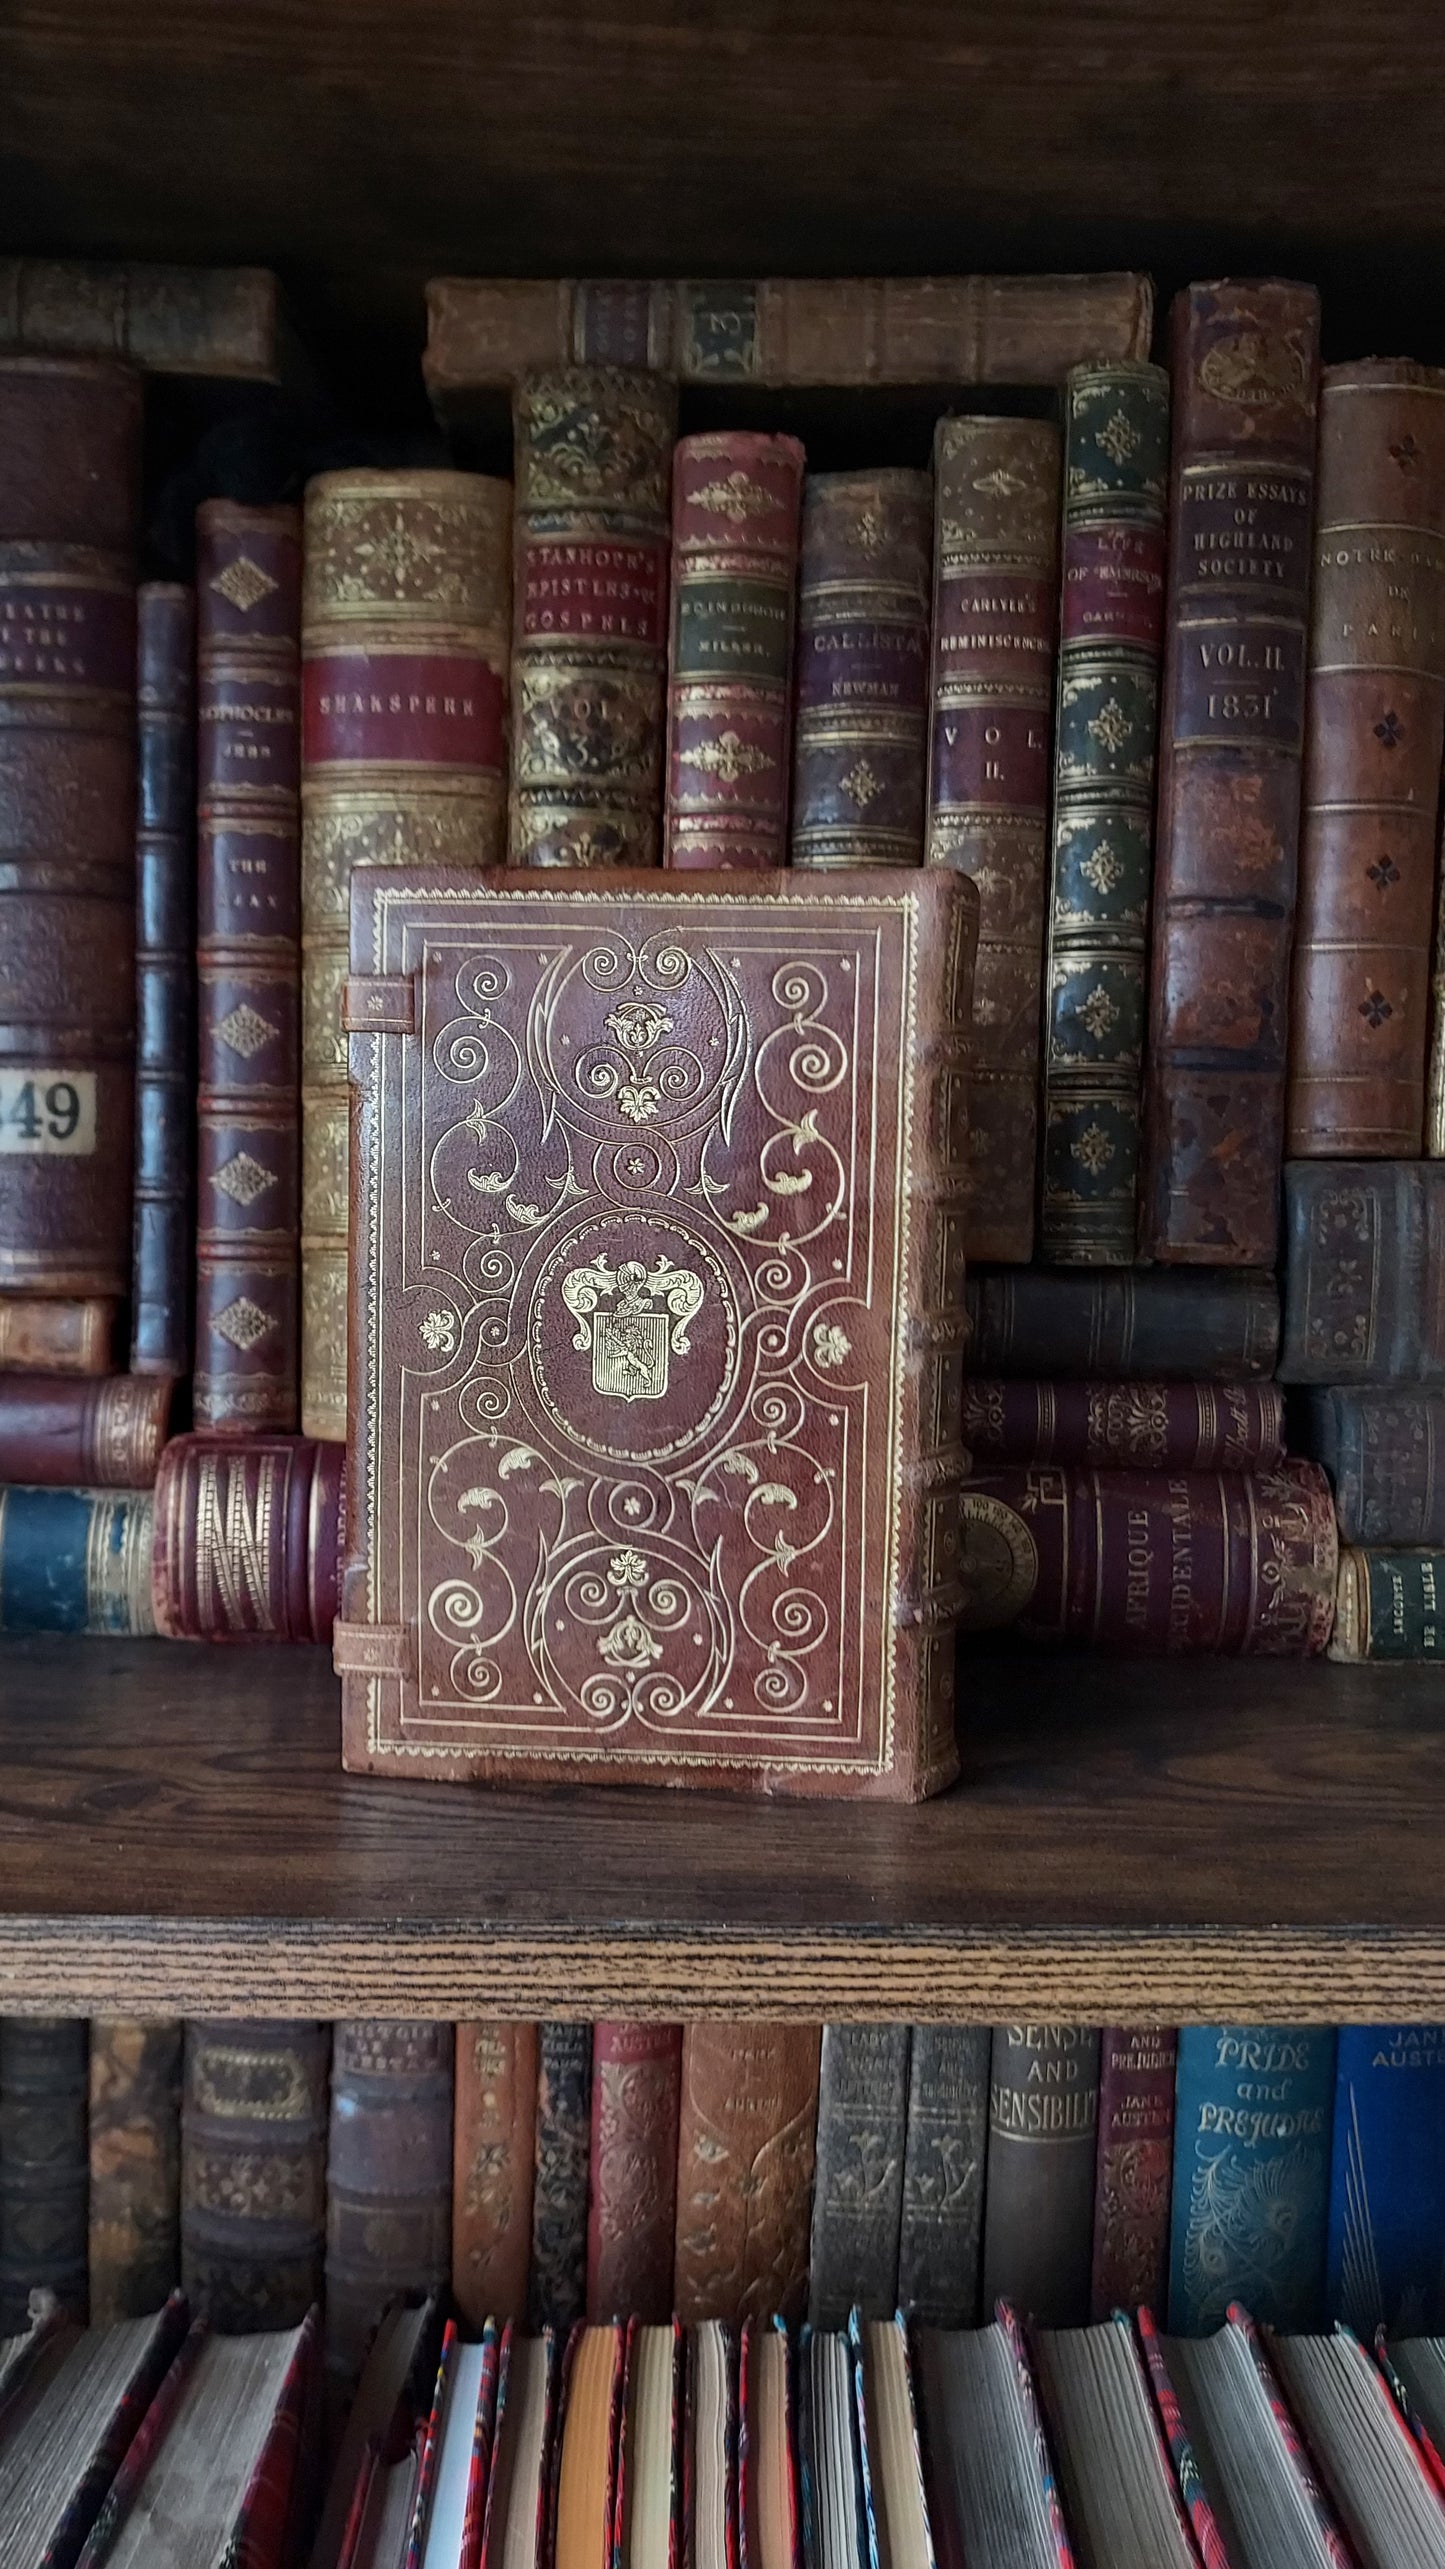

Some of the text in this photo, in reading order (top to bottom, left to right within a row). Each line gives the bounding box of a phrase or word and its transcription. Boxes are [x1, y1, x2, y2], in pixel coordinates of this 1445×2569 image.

[1182, 482, 1307, 506] PRIZE ESSAYS
[1234, 508, 1258, 526] OF
[1193, 531, 1294, 553] HIGHLAND
[1198, 558, 1286, 578] SOCIETY
[1206, 693, 1272, 720] 1831
[0, 1080, 80, 1140] 49
[1126, 1509, 1155, 1629] AFRIQUE
[1421, 1561, 1437, 1612] LISLE
[1130, 2034, 1161, 2049] AND
[1389, 2030, 1445, 2048] JAN
[1214, 2036, 1310, 2072] PRIDE
[1027, 2059, 1078, 2083] AND
[1236, 2077, 1294, 2101] and
[1196, 2100, 1325, 2150] PREJUDICE
